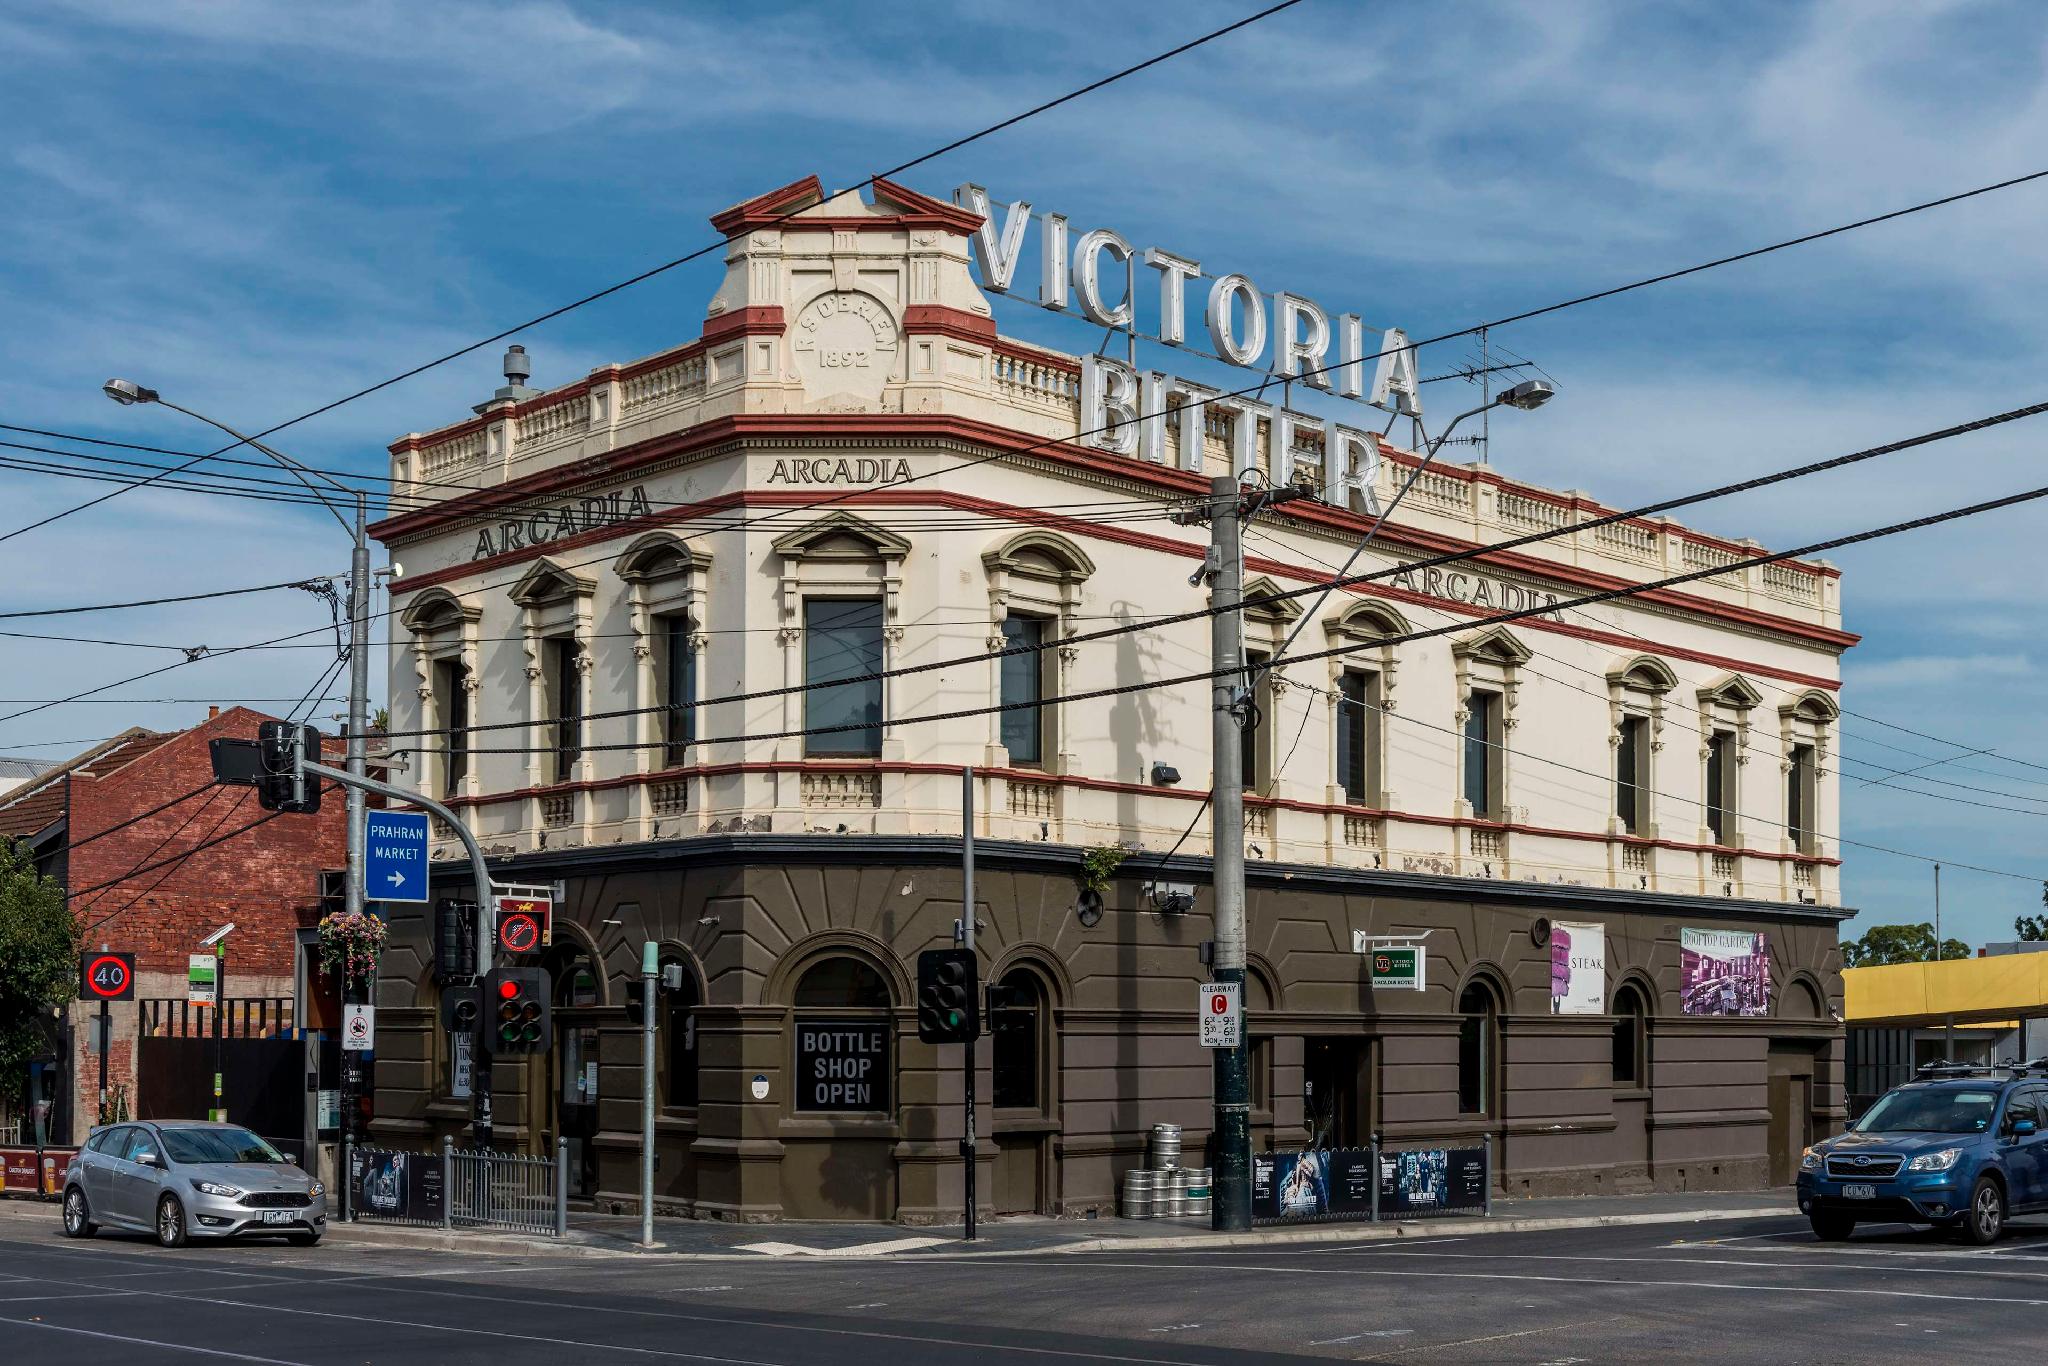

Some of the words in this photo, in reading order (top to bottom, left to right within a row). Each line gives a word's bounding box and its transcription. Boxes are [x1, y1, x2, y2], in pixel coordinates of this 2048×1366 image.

[957, 182, 1424, 416] VICTORIA
[819, 350, 870, 368] 1892
[1080, 352, 1382, 516] BITTER
[767, 458, 915, 485] ARCADIA
[472, 485, 653, 561] ARCADIA
[1390, 561, 1566, 623] ARCADIA
[371, 825, 423, 840] PRAHRAN
[375, 846, 419, 860] MARKET
[1719, 934, 1751, 949] GARDEN
[1571, 957, 1604, 970] STEAK
[94, 967, 123, 984] 40
[1202, 985, 1237, 993] CLEARWAY
[1215, 996, 1224, 1012] C
[803, 1032, 882, 1053] BOTTLE
[814, 1057, 872, 1079] SHOP
[815, 1083, 871, 1104] OPEN
